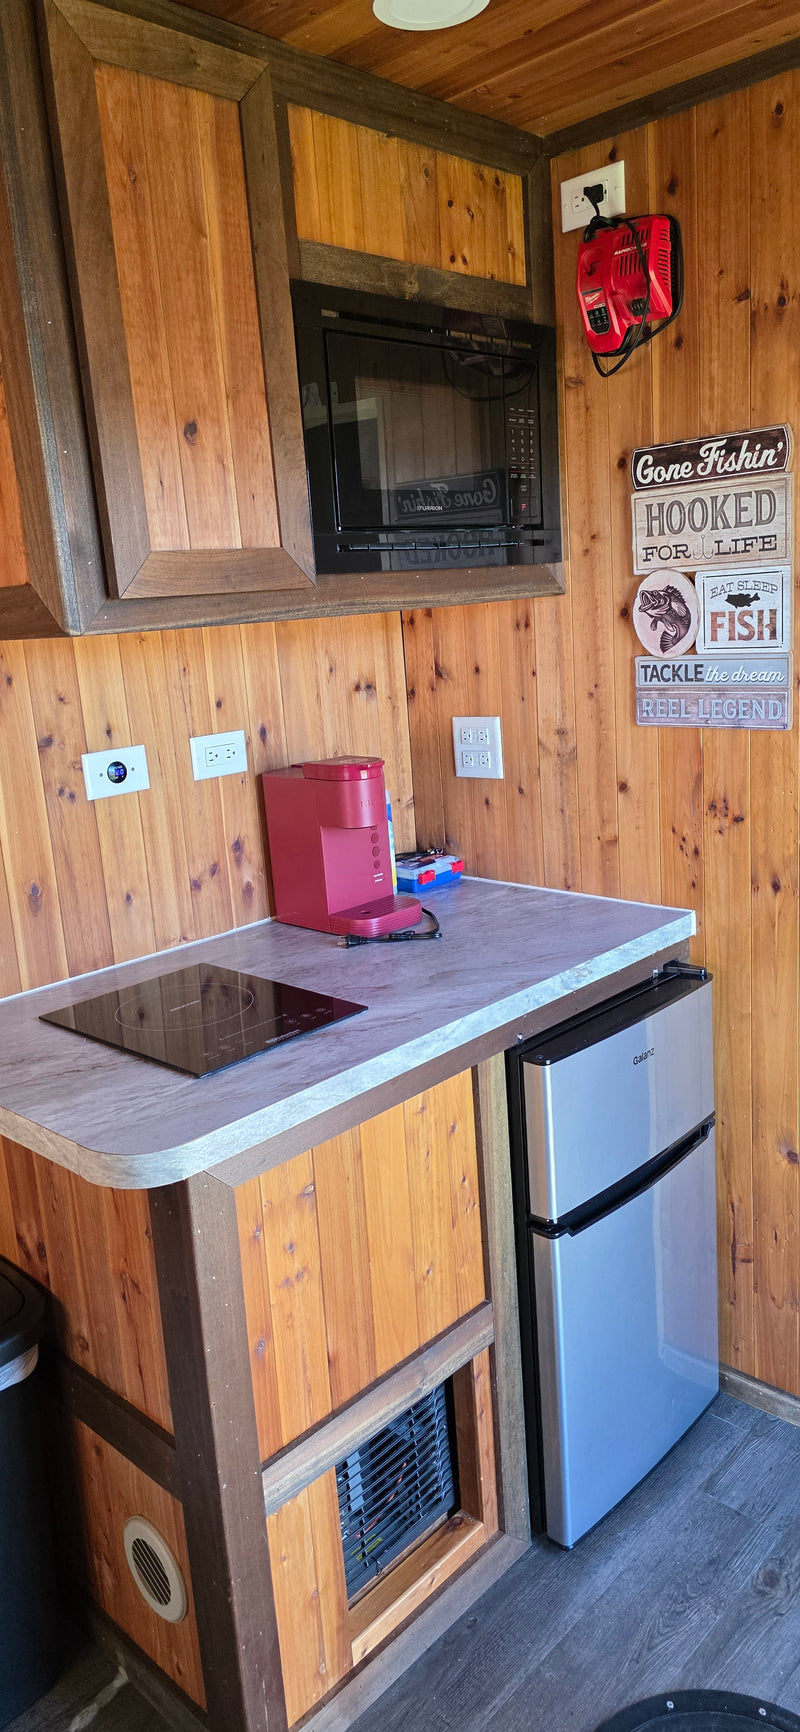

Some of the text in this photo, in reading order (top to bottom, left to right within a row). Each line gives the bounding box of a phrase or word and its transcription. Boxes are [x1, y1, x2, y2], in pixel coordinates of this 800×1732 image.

[636, 439, 784, 484] Gone Fishin'
[645, 489, 777, 538] HOOKED
[643, 534, 778, 563] FOR LIFE
[710, 579, 779, 600] EAT SLEEP
[709, 608, 778, 643] FISH
[640, 663, 785, 683] TACKLE the dream
[642, 698, 783, 721] REEL LEGEND
[632, 1047, 655, 1066] Galanz
